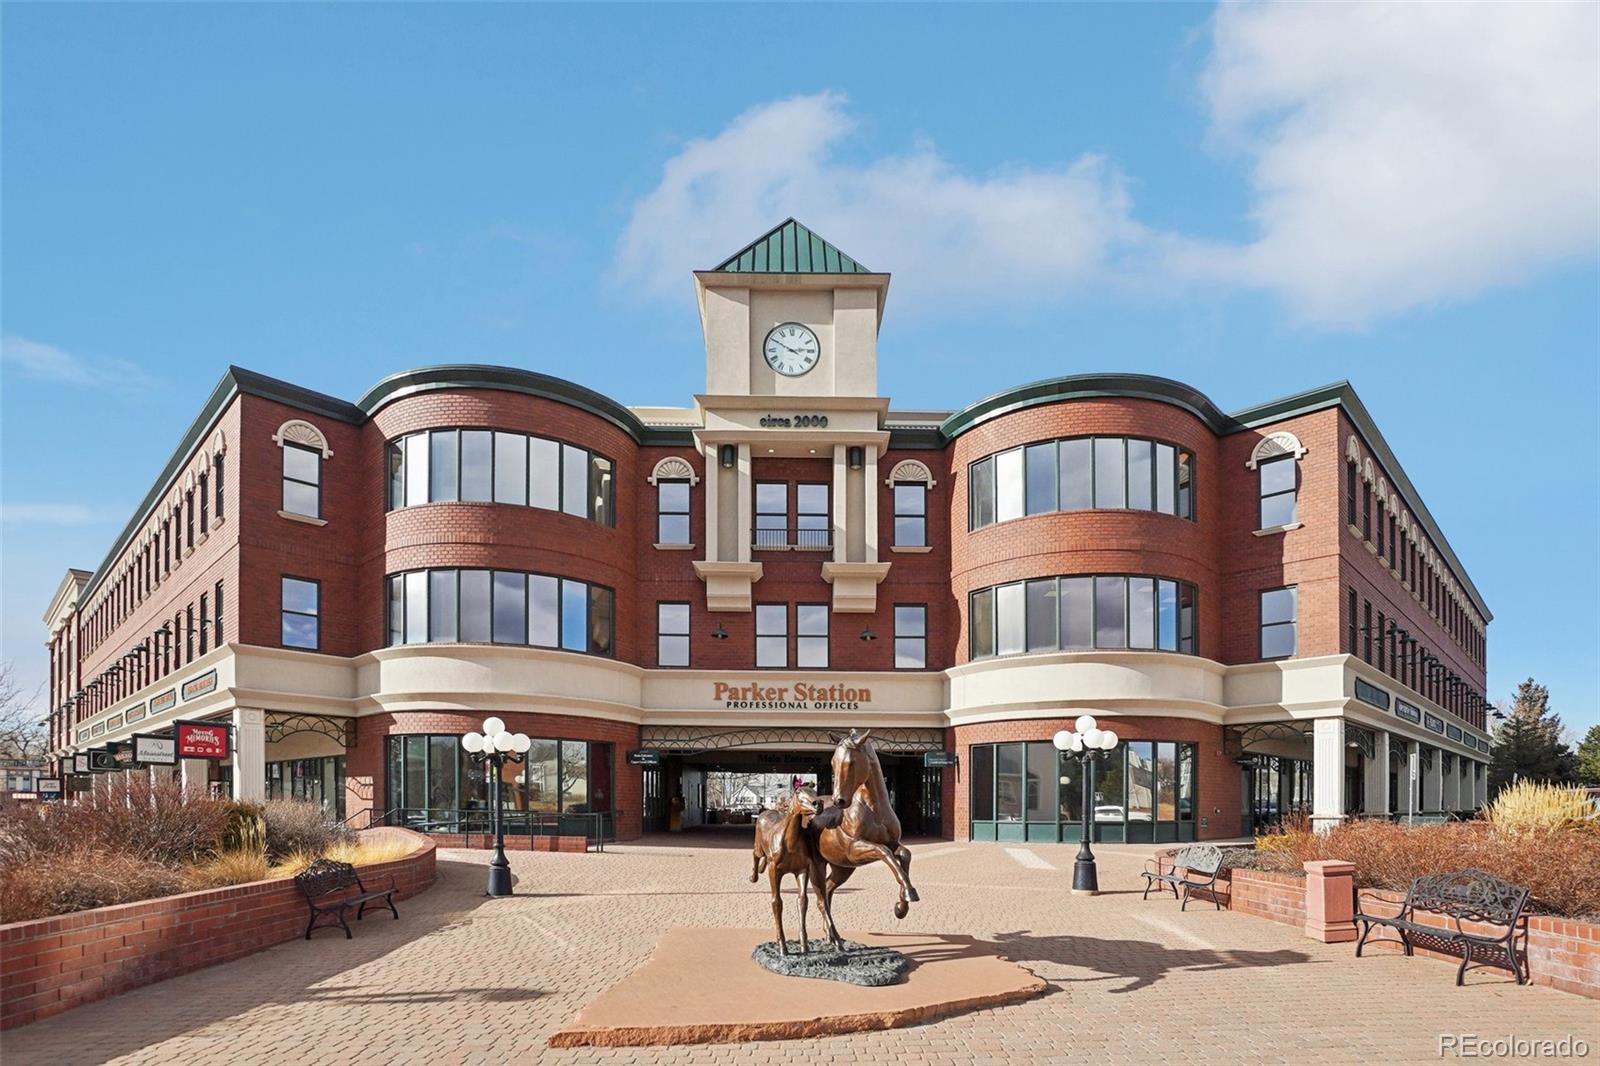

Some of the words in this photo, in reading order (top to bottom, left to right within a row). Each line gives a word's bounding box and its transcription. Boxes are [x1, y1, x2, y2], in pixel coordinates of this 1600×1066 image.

[760, 414, 791, 427] circa
[794, 415, 828, 428] 2000
[713, 682, 788, 700] Parker
[794, 682, 872, 702] Station
[726, 701, 808, 709] PROFESSIONAL
[814, 702, 859, 710] OFFICES
